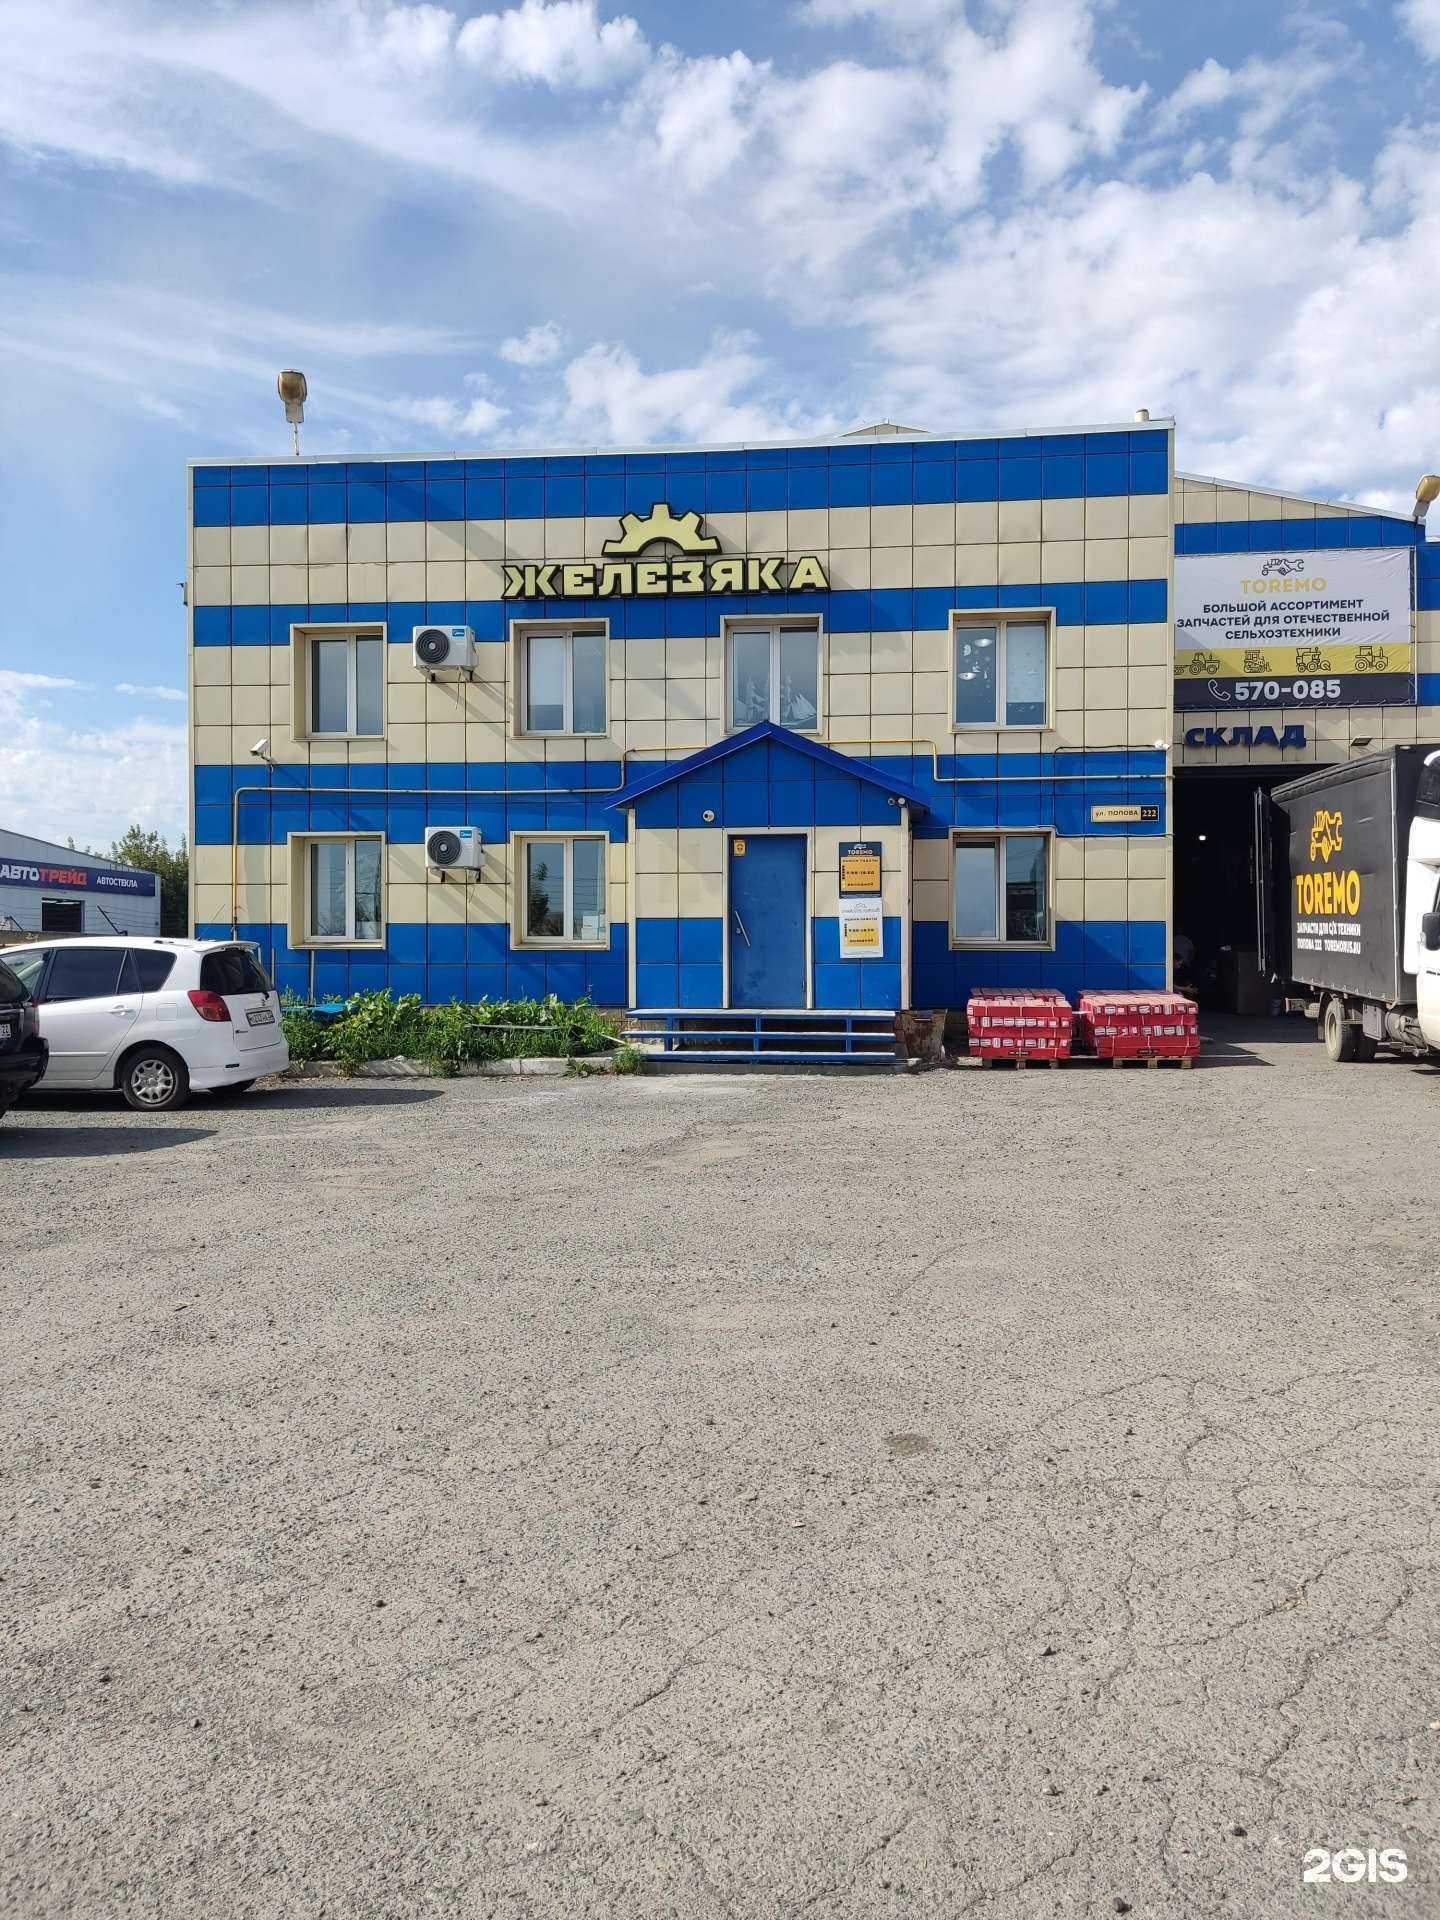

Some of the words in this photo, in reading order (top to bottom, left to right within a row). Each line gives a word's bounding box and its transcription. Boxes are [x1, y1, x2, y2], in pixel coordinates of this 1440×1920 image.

[501, 556, 831, 599] ЖЕЛЕЗЯКА
[1241, 576, 1328, 594] TOREMO
[1203, 600, 1267, 613] БОЛЬШОЙ
[1270, 599, 1364, 612] АССОРТИМЕНТ
[1176, 615, 1251, 628] ЗАПЧАСТЕЙ
[1253, 615, 1280, 627] ДЛЯ
[1283, 609, 1390, 624] ОТЕЧЕСТВЕННОЙ
[1225, 627, 1341, 640] СЕЛЬХОЗТЕХНИКИ
[1234, 679, 1341, 700] 570-085
[1184, 725, 1307, 749] СКЛАД
[1142, 809, 1157, 817] 222
[0, 864, 88, 886] АВТОТРЕЙД
[96, 875, 138, 888] АВТОСТЕКЛА
[1296, 869, 1361, 916] TOREMO
